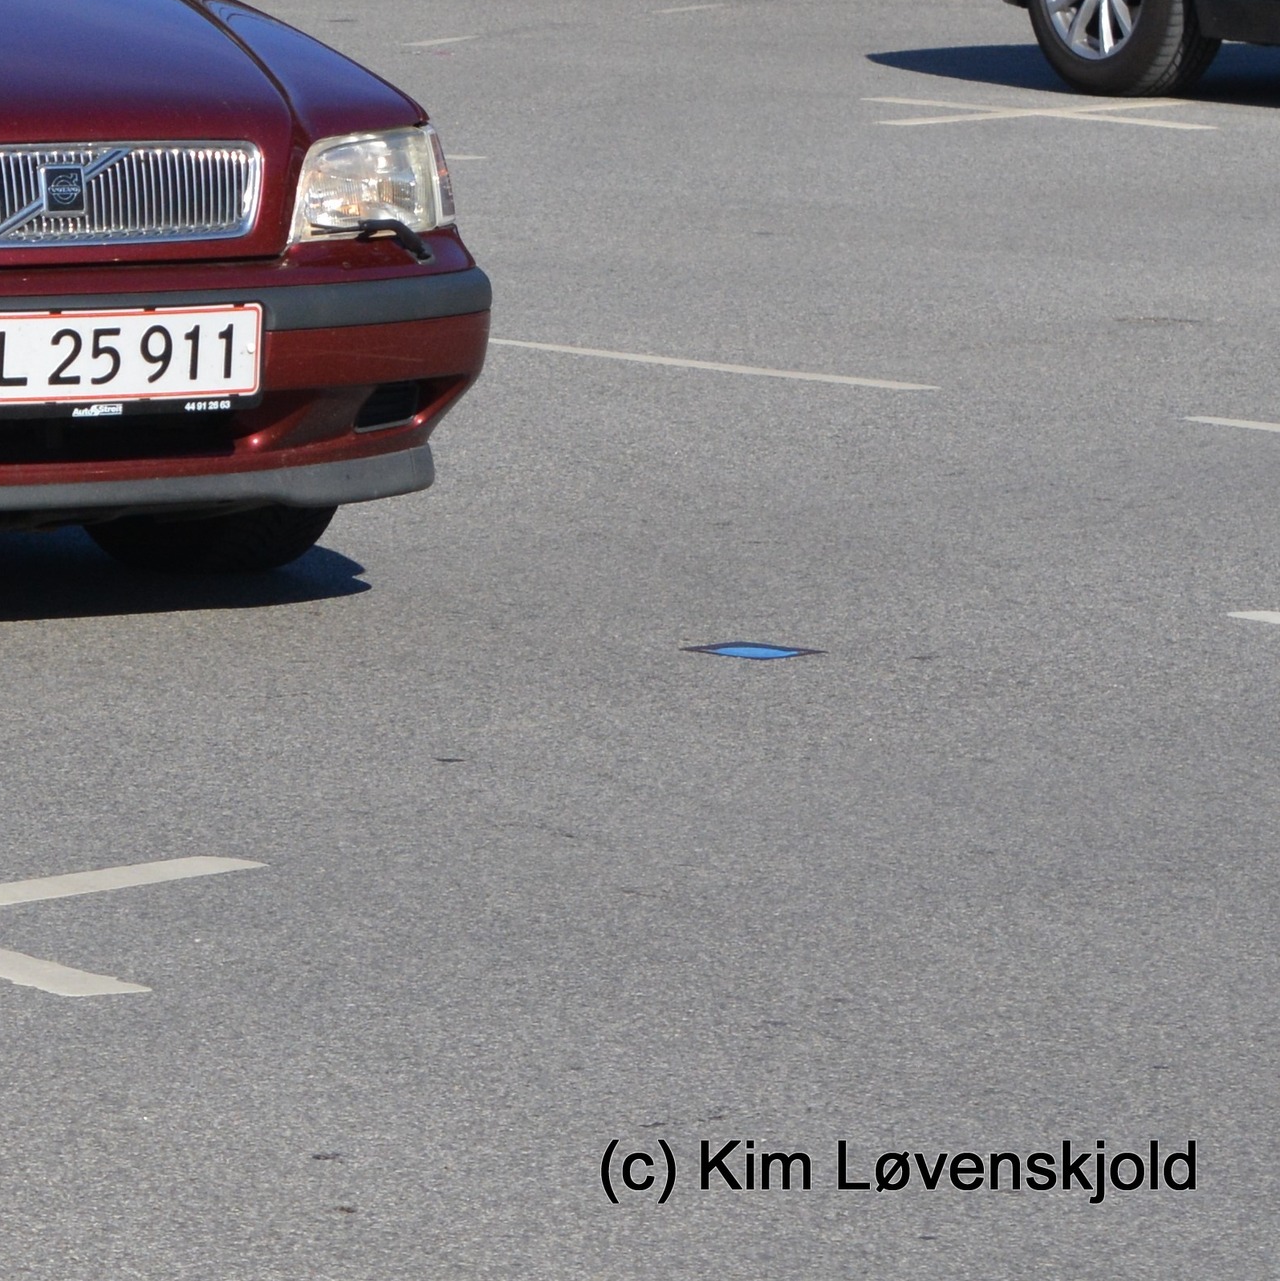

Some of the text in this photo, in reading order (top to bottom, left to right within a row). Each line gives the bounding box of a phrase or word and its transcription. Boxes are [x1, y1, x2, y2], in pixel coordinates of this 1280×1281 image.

[48, 328, 121, 385] 25
[140, 323, 234, 383] 911
[184, 401, 196, 412] 44
[196, 401, 207, 411] 91
